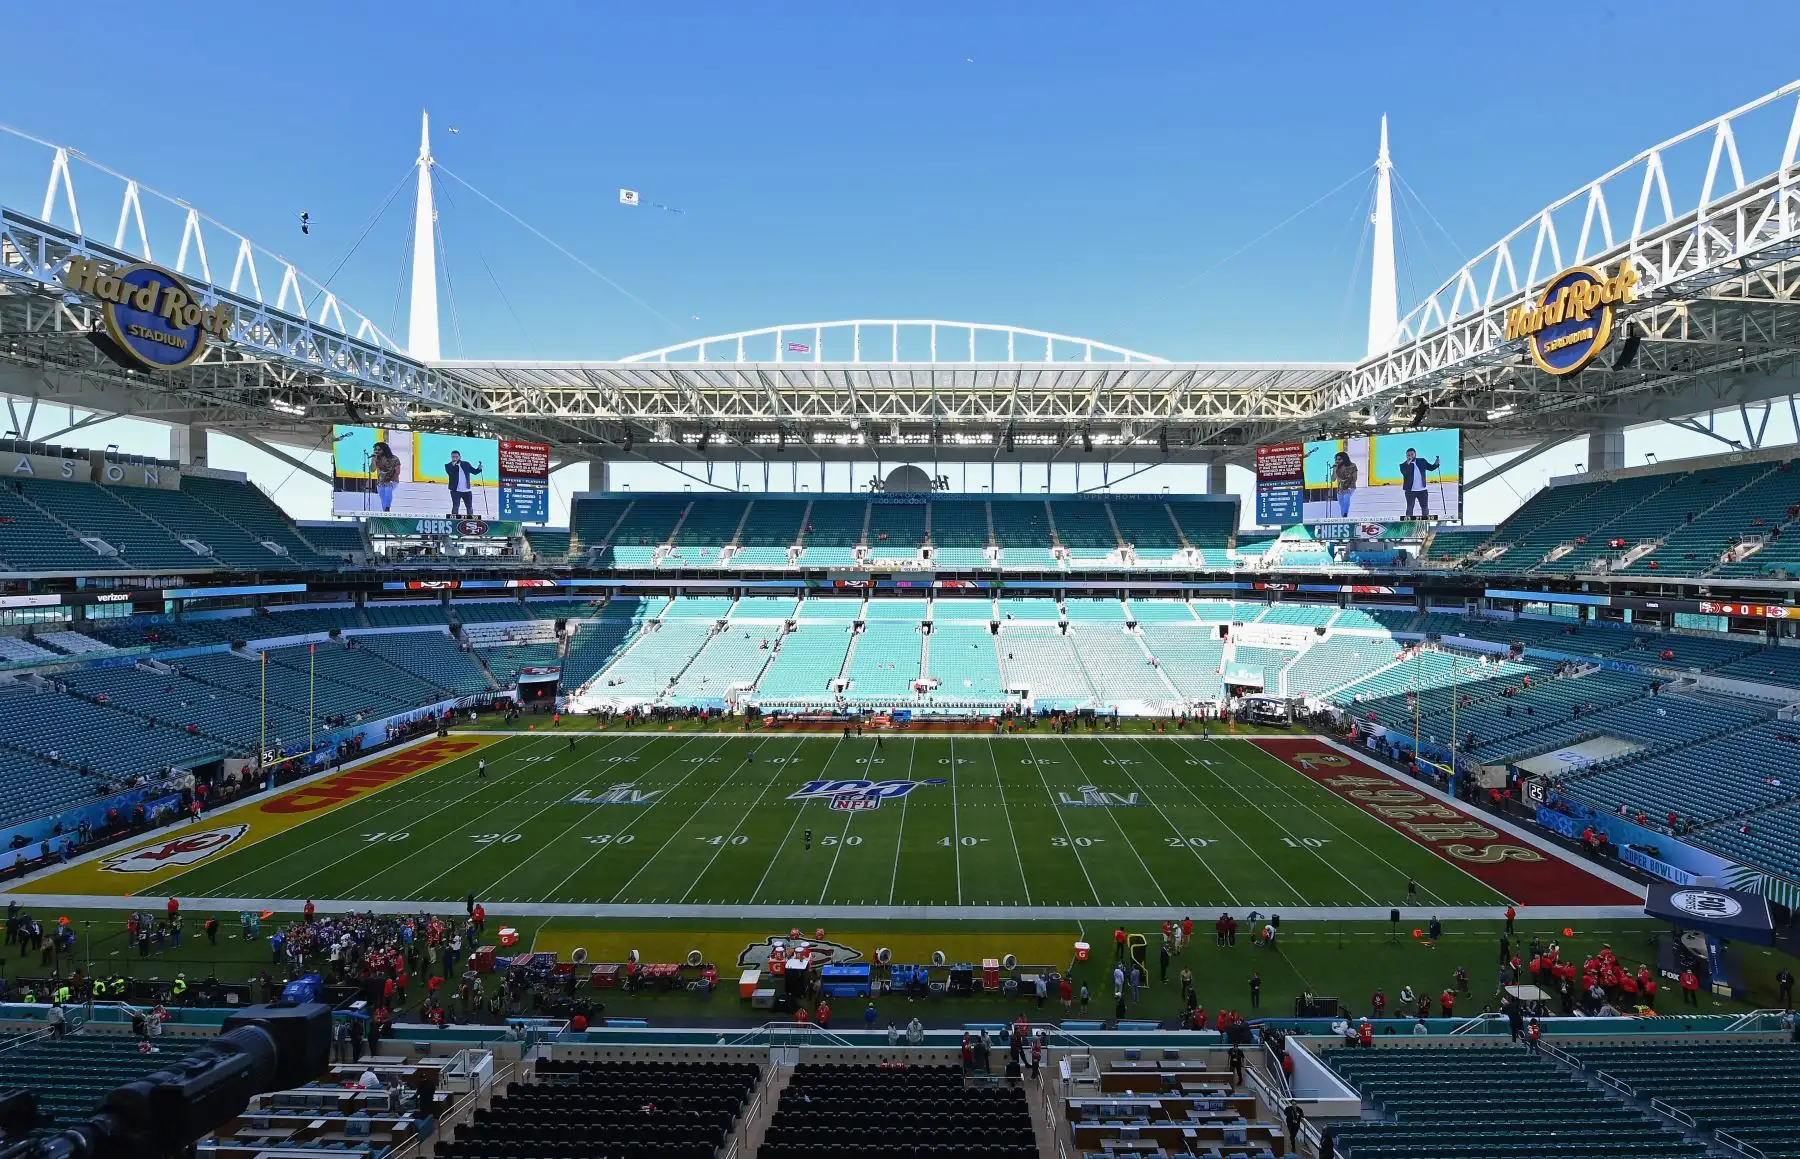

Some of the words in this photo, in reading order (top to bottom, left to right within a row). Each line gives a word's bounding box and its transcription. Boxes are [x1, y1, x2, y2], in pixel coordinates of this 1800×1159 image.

[66, 255, 160, 313] Hard
[161, 287, 233, 342] Rock
[1504, 286, 1569, 340] Hard
[1566, 258, 1638, 321] Rock
[128, 324, 187, 349] STADIUM
[1544, 327, 1593, 353] STADIUM
[416, 520, 452, 534] 49ERS
[1314, 524, 1350, 538] CHIEFS
[97, 593, 128, 602] verizon
[1741, 605, 1749, 614] 0
[259, 740, 480, 814] CHIEFS
[1530, 786, 1543, 799] 25
[836, 800, 876, 809] NFL
[1624, 849, 1648, 869] SUPER
[1650, 862, 1672, 879] BOWL
[1675, 871, 1689, 886] LIV
[1697, 895, 1726, 912] FOX
[773, 963, 780, 971] G
[1662, 970, 1680, 981] FOX
